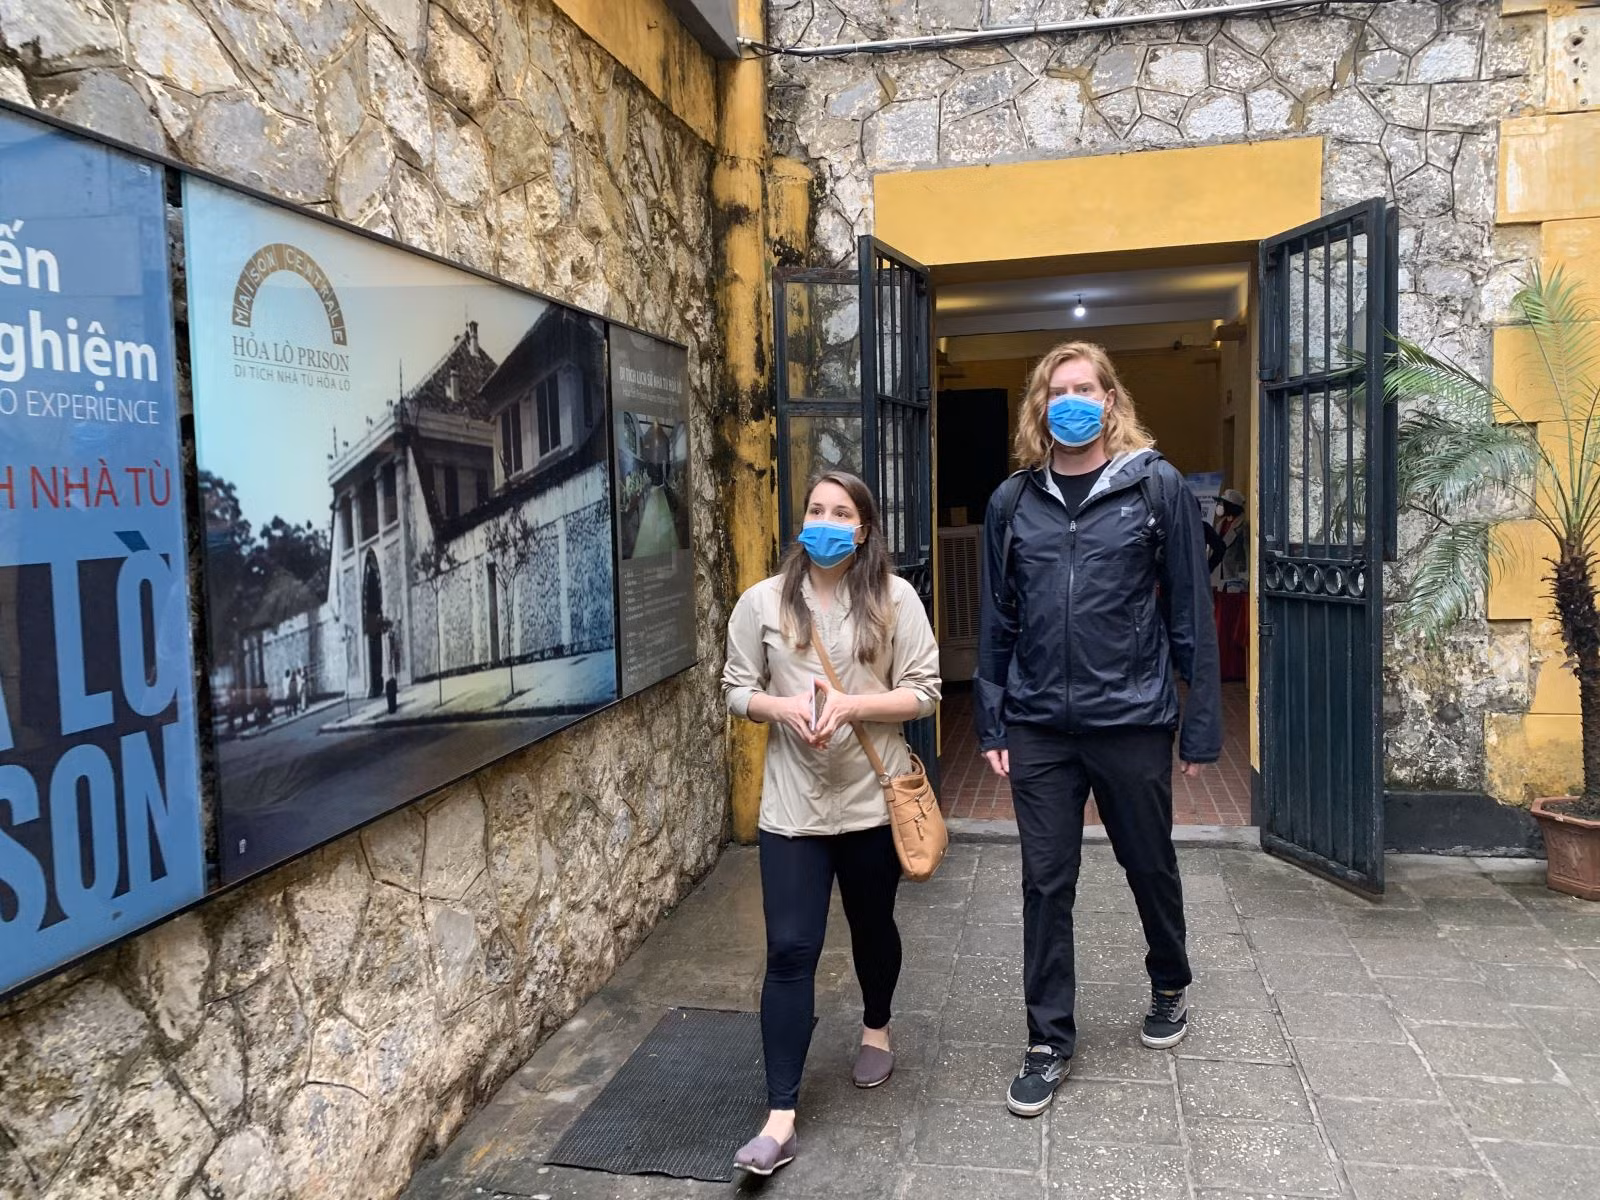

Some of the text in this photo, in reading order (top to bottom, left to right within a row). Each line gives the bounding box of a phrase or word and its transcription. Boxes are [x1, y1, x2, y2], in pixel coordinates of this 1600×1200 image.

[234, 248, 344, 342] MAISON CENTRALE
[0, 310, 159, 391] ghiệm
[297, 346, 349, 372] PRISON
[26, 390, 160, 424] EXPERIENCE
[30, 458, 119, 509] NHÀ
[125, 459, 171, 507] TÙ
